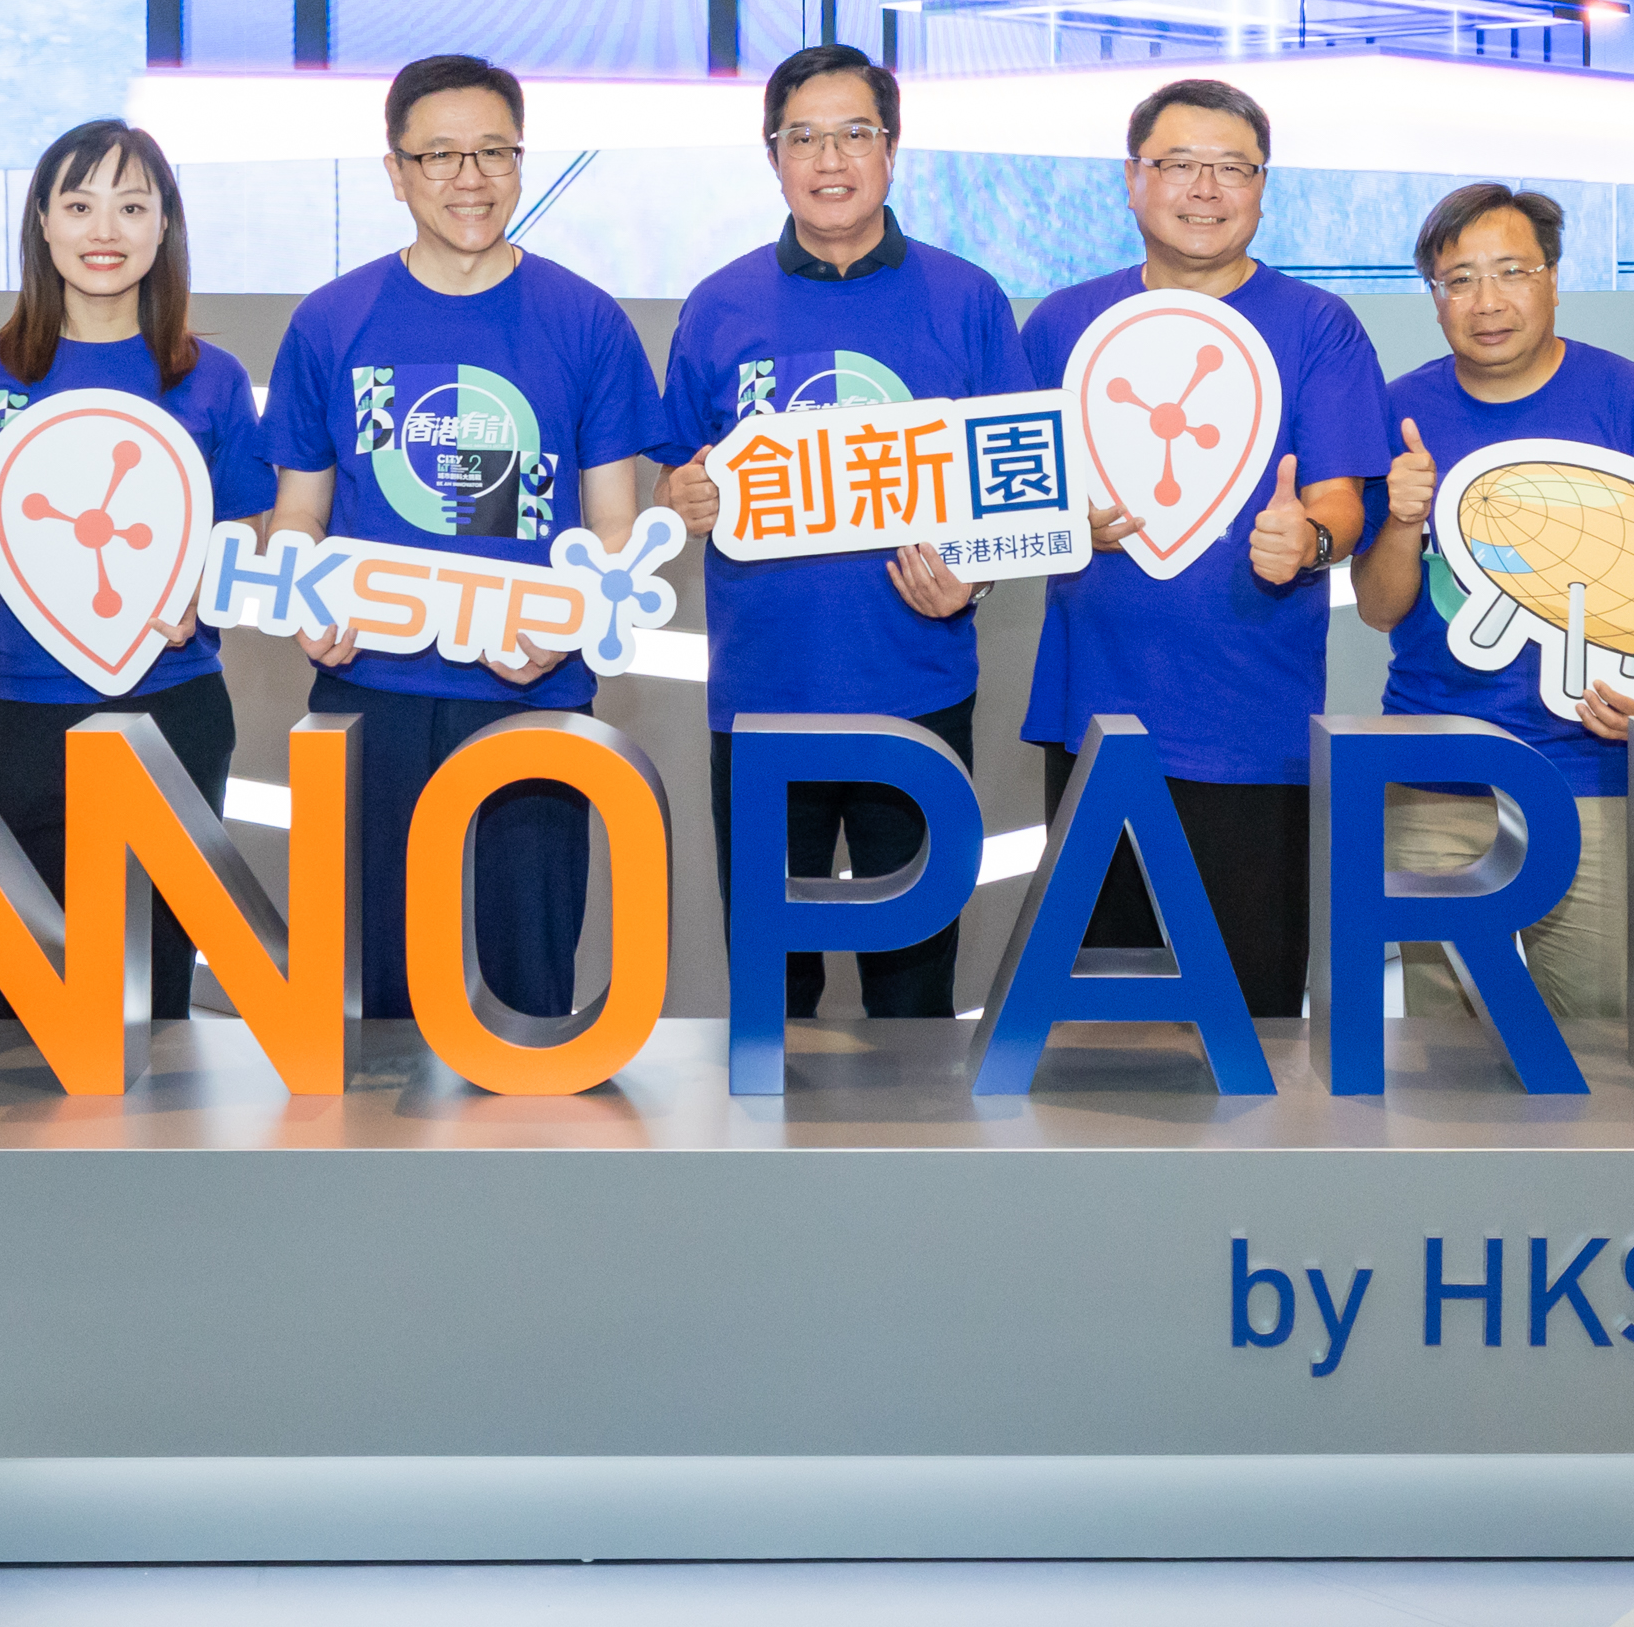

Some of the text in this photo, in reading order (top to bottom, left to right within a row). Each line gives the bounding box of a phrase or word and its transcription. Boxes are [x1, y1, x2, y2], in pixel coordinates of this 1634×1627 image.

[407, 411, 513, 446] 香港有計
[437, 454, 463, 464] CITY
[469, 454, 482, 474] 2
[726, 410, 1070, 541] 創新園
[938, 530, 1072, 567] 香港科技園
[214, 536, 585, 652] HKSTP
[1227, 1238, 1374, 1376] by
